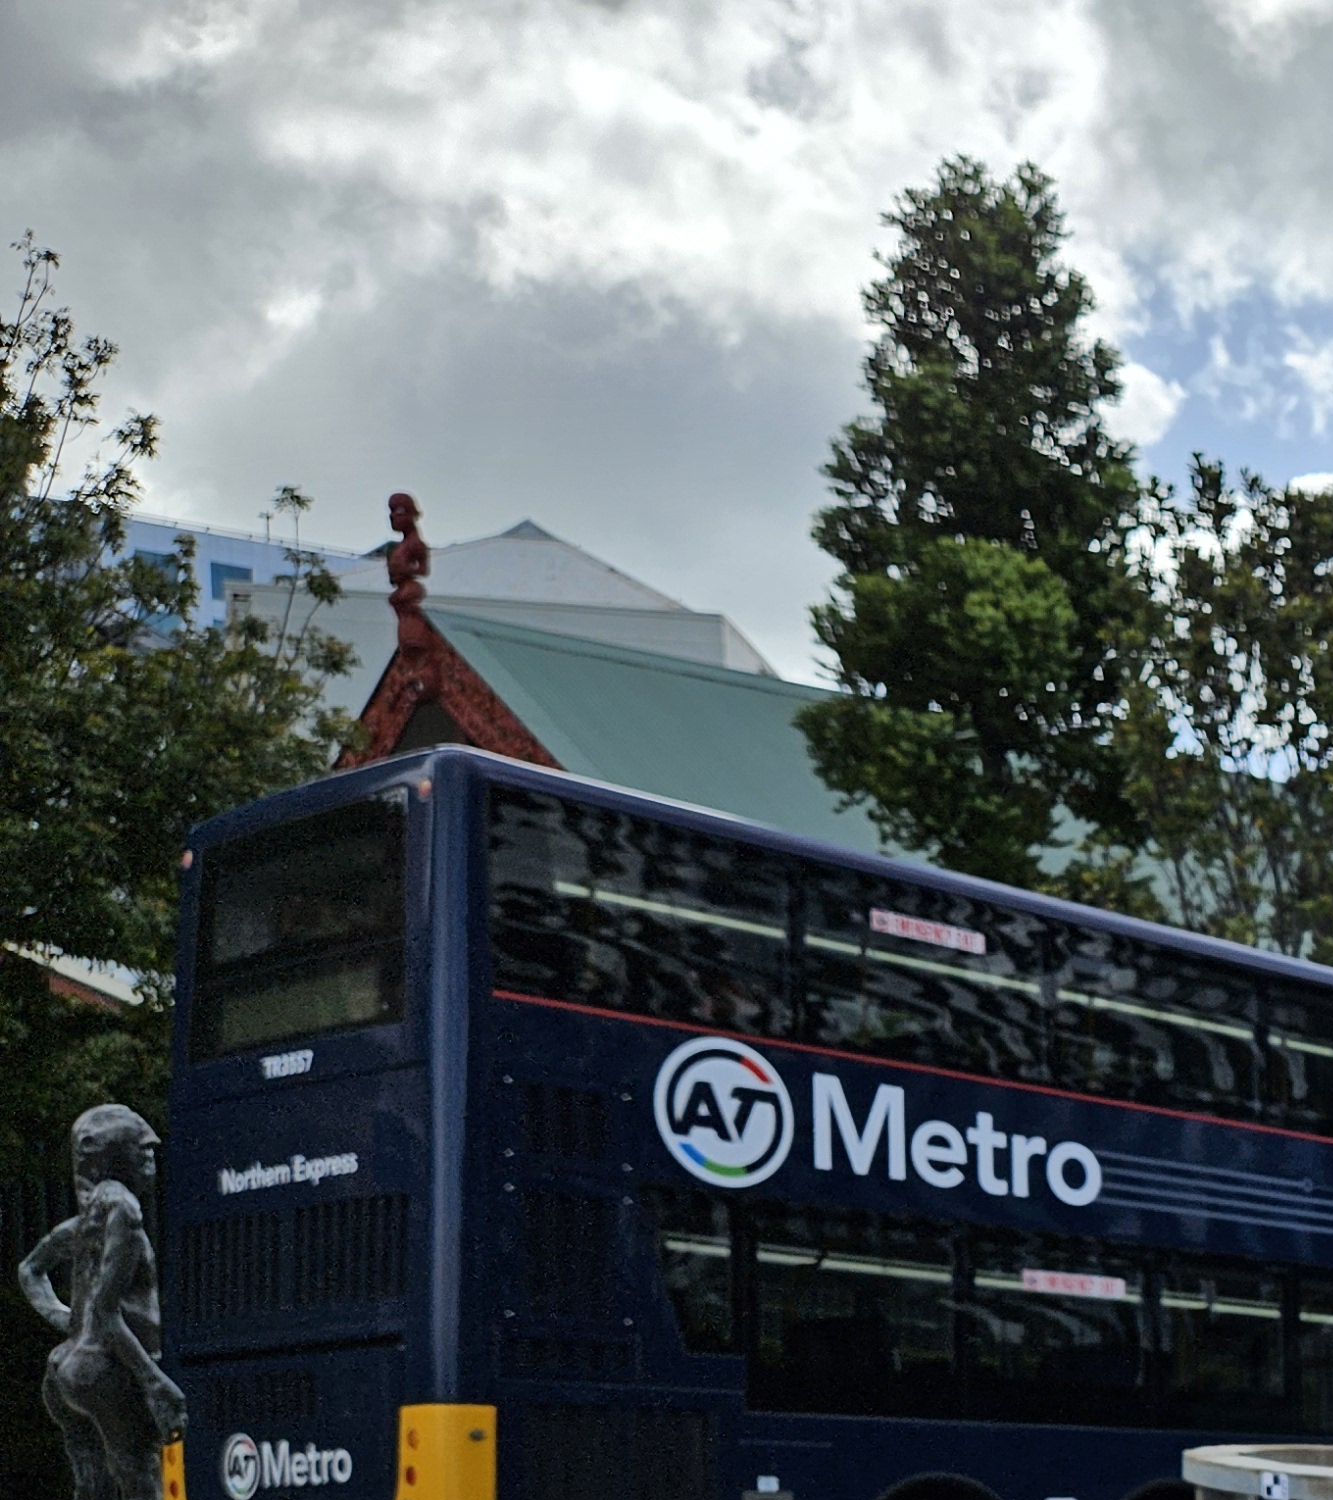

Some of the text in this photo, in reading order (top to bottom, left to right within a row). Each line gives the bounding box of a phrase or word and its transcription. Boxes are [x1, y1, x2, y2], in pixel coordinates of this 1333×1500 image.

[812, 1072, 1102, 1206] Metro
[218, 1152, 359, 1196] Northern Express
[260, 1439, 353, 1489] Metro
